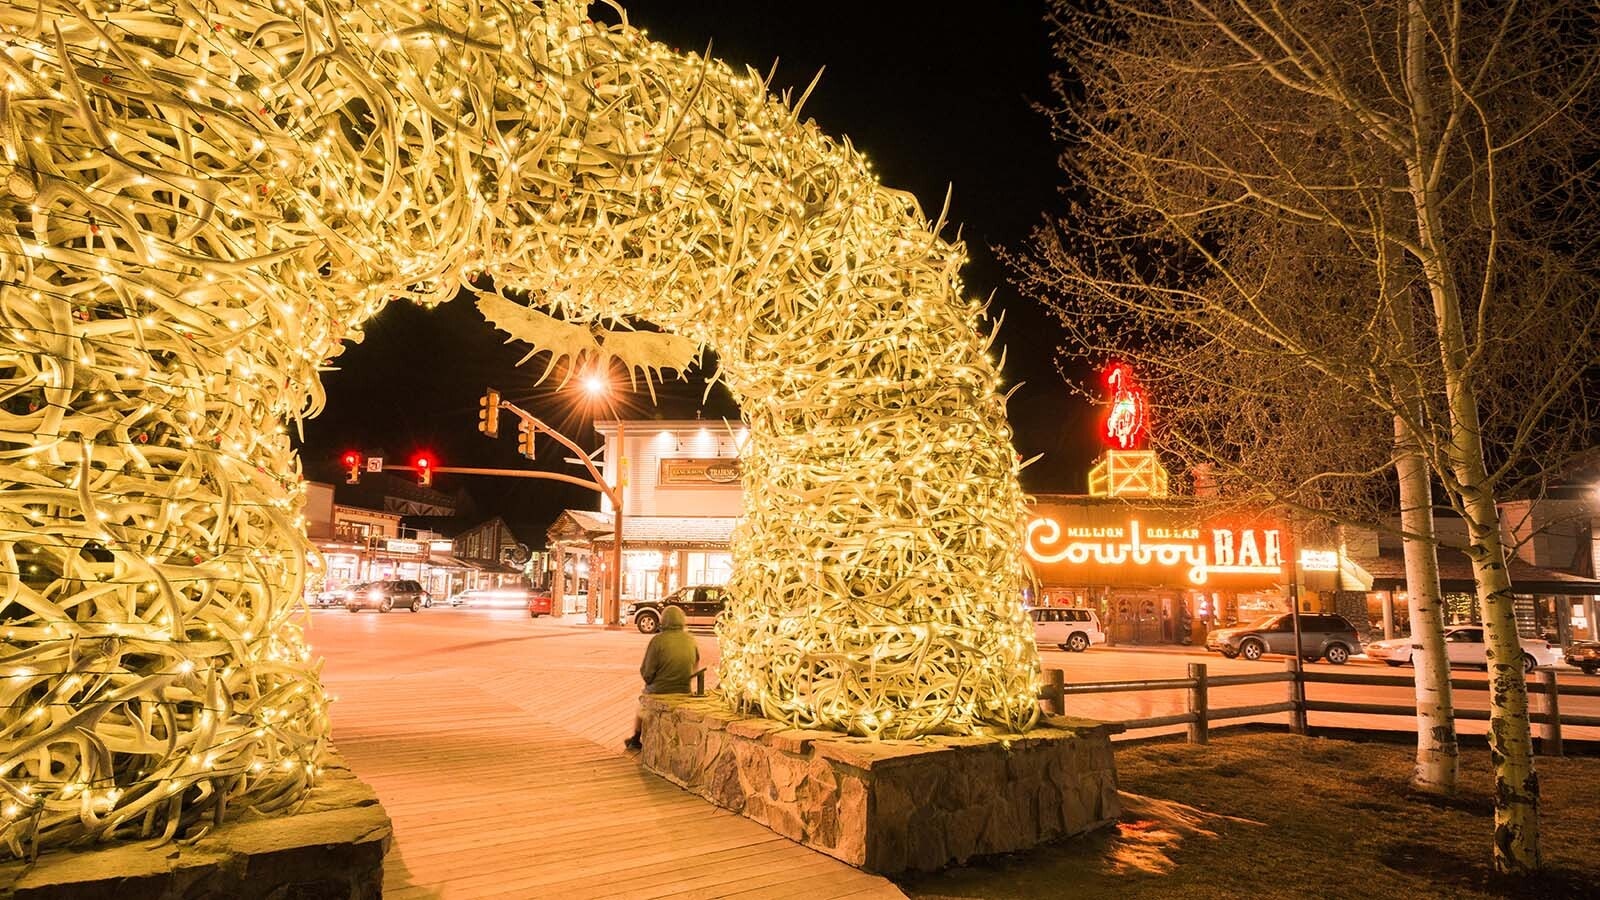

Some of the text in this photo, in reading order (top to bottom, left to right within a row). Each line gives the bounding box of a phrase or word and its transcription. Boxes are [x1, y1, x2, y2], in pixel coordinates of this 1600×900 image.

[1024, 518, 1208, 585] Cowboy
[1067, 527, 1199, 539] MILLION DOLLAR
